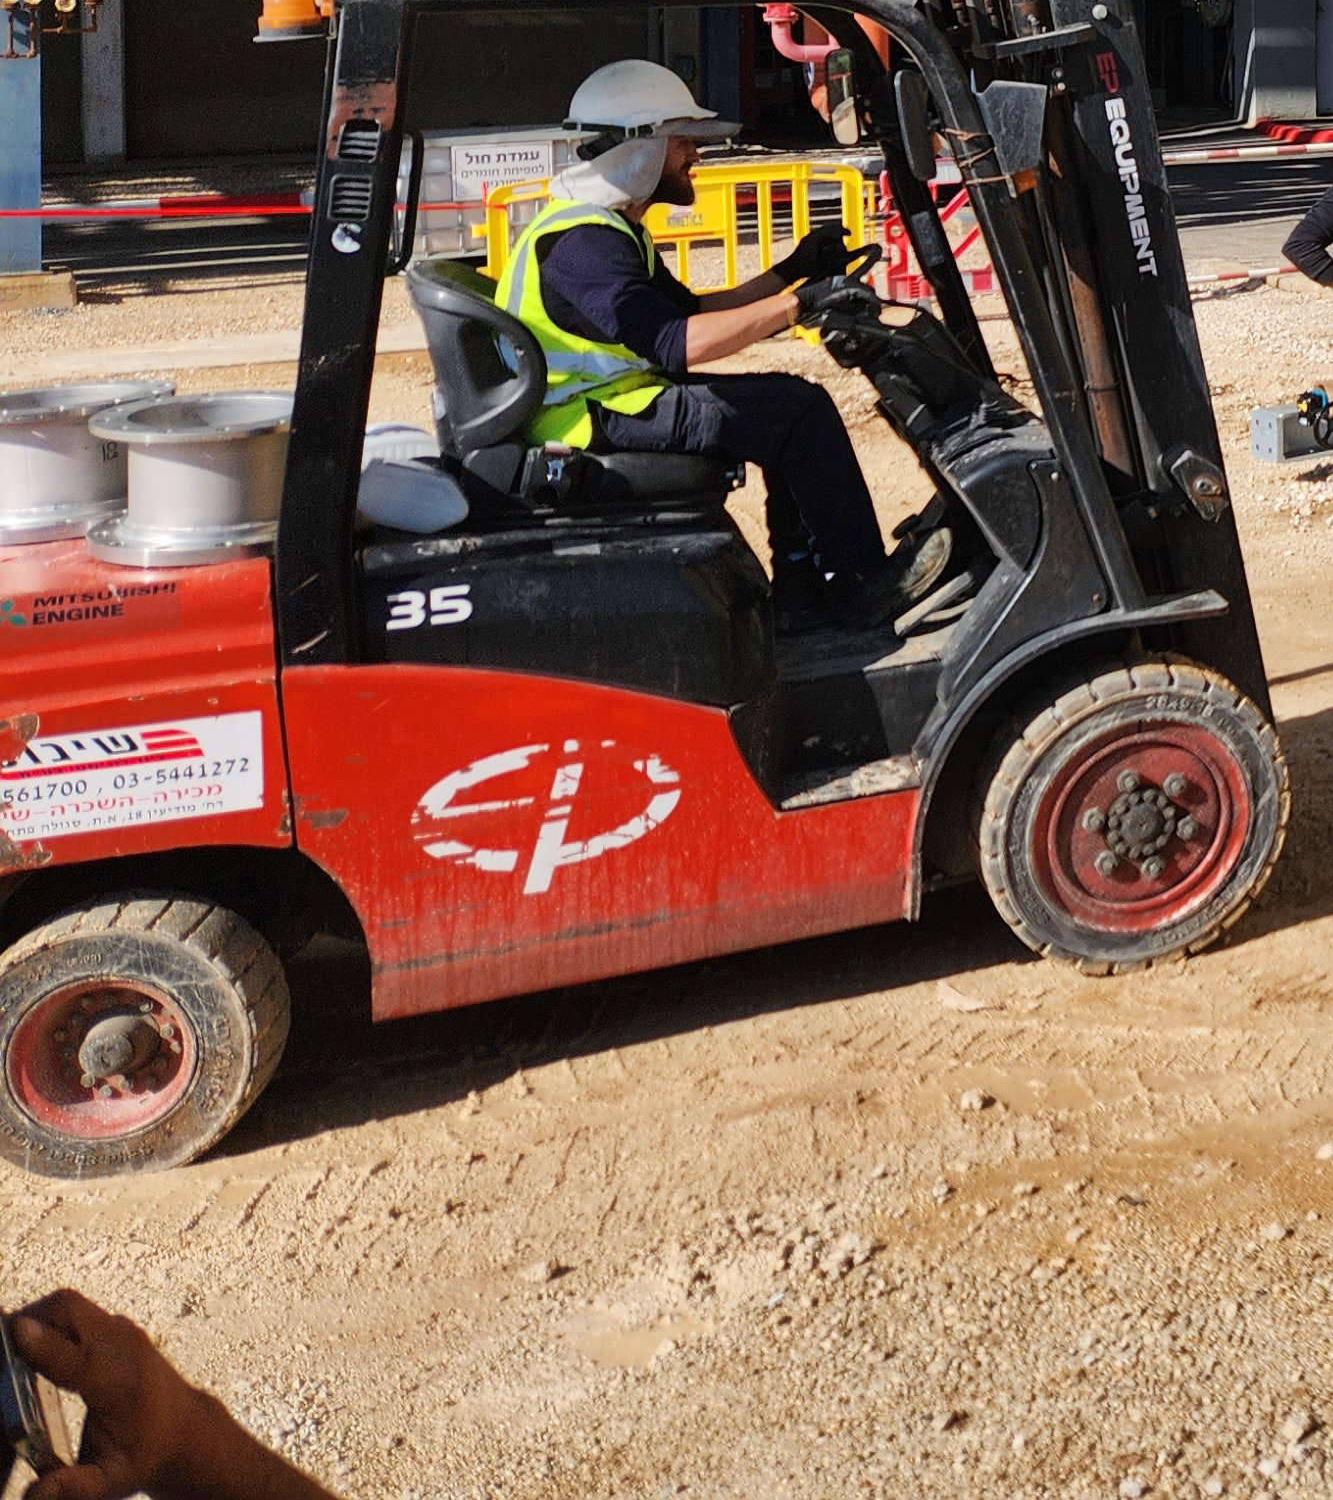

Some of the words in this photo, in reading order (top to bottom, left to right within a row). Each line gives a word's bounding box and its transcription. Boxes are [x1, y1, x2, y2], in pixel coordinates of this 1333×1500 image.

[1096, 52, 1120, 93] EP
[464, 152, 491, 165] חול
[496, 150, 540, 163] עמדת
[460, 168, 499, 179] חומרים
[503, 163, 545, 176] לספיחת
[1104, 97, 1158, 277] EQUIPMENT
[33, 583, 176, 608] MITSUBISHI
[32, 603, 125, 626] ENGINE
[386, 584, 473, 631] 35
[113, 757, 250, 792] 03-5441272
[147, 804, 196, 820] מודיעין
[41, 819, 82, 833] סגולה
